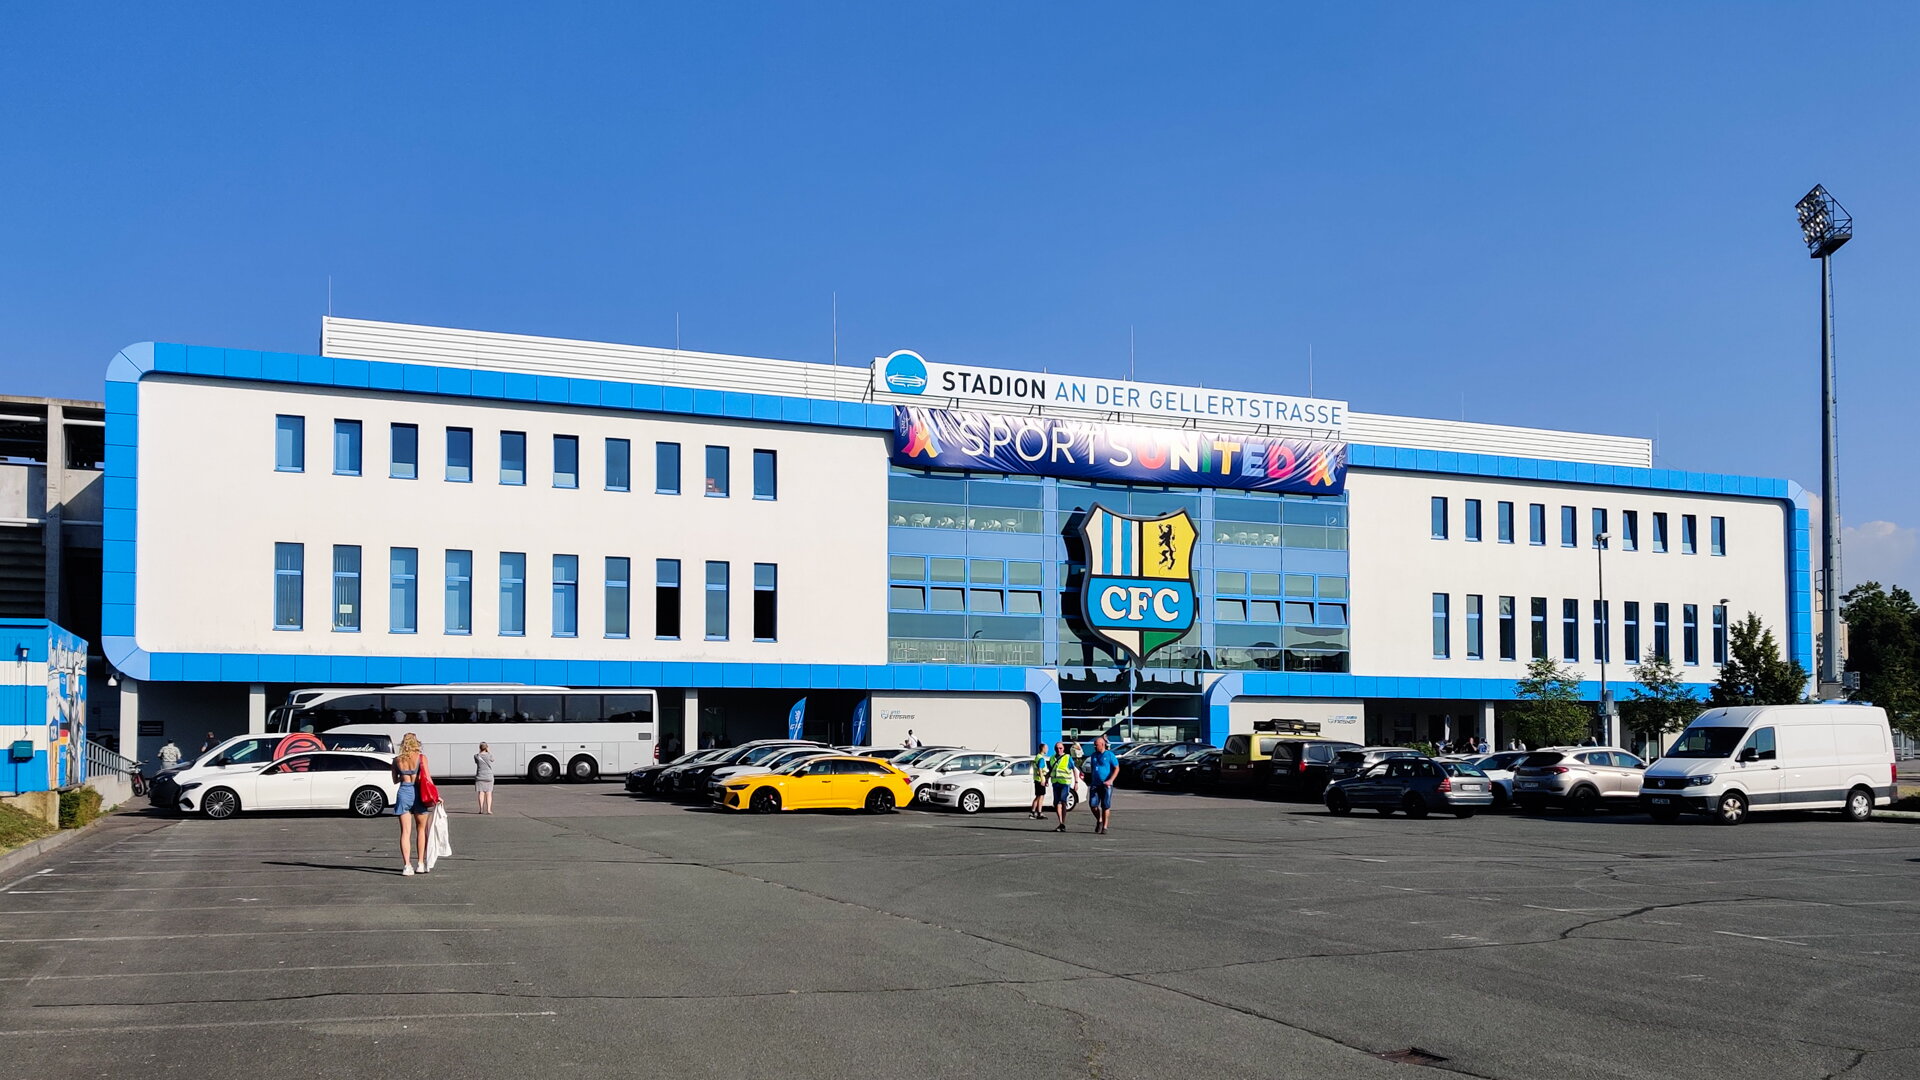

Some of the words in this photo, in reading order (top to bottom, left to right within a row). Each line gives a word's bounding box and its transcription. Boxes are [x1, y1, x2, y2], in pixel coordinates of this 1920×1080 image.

[942, 371, 1046, 400] STADION
[1055, 382, 1086, 403] AN
[1096, 385, 1140, 408] DER
[1150, 390, 1342, 425] GELLERTSTRASSE
[1100, 585, 1180, 622] CFC
